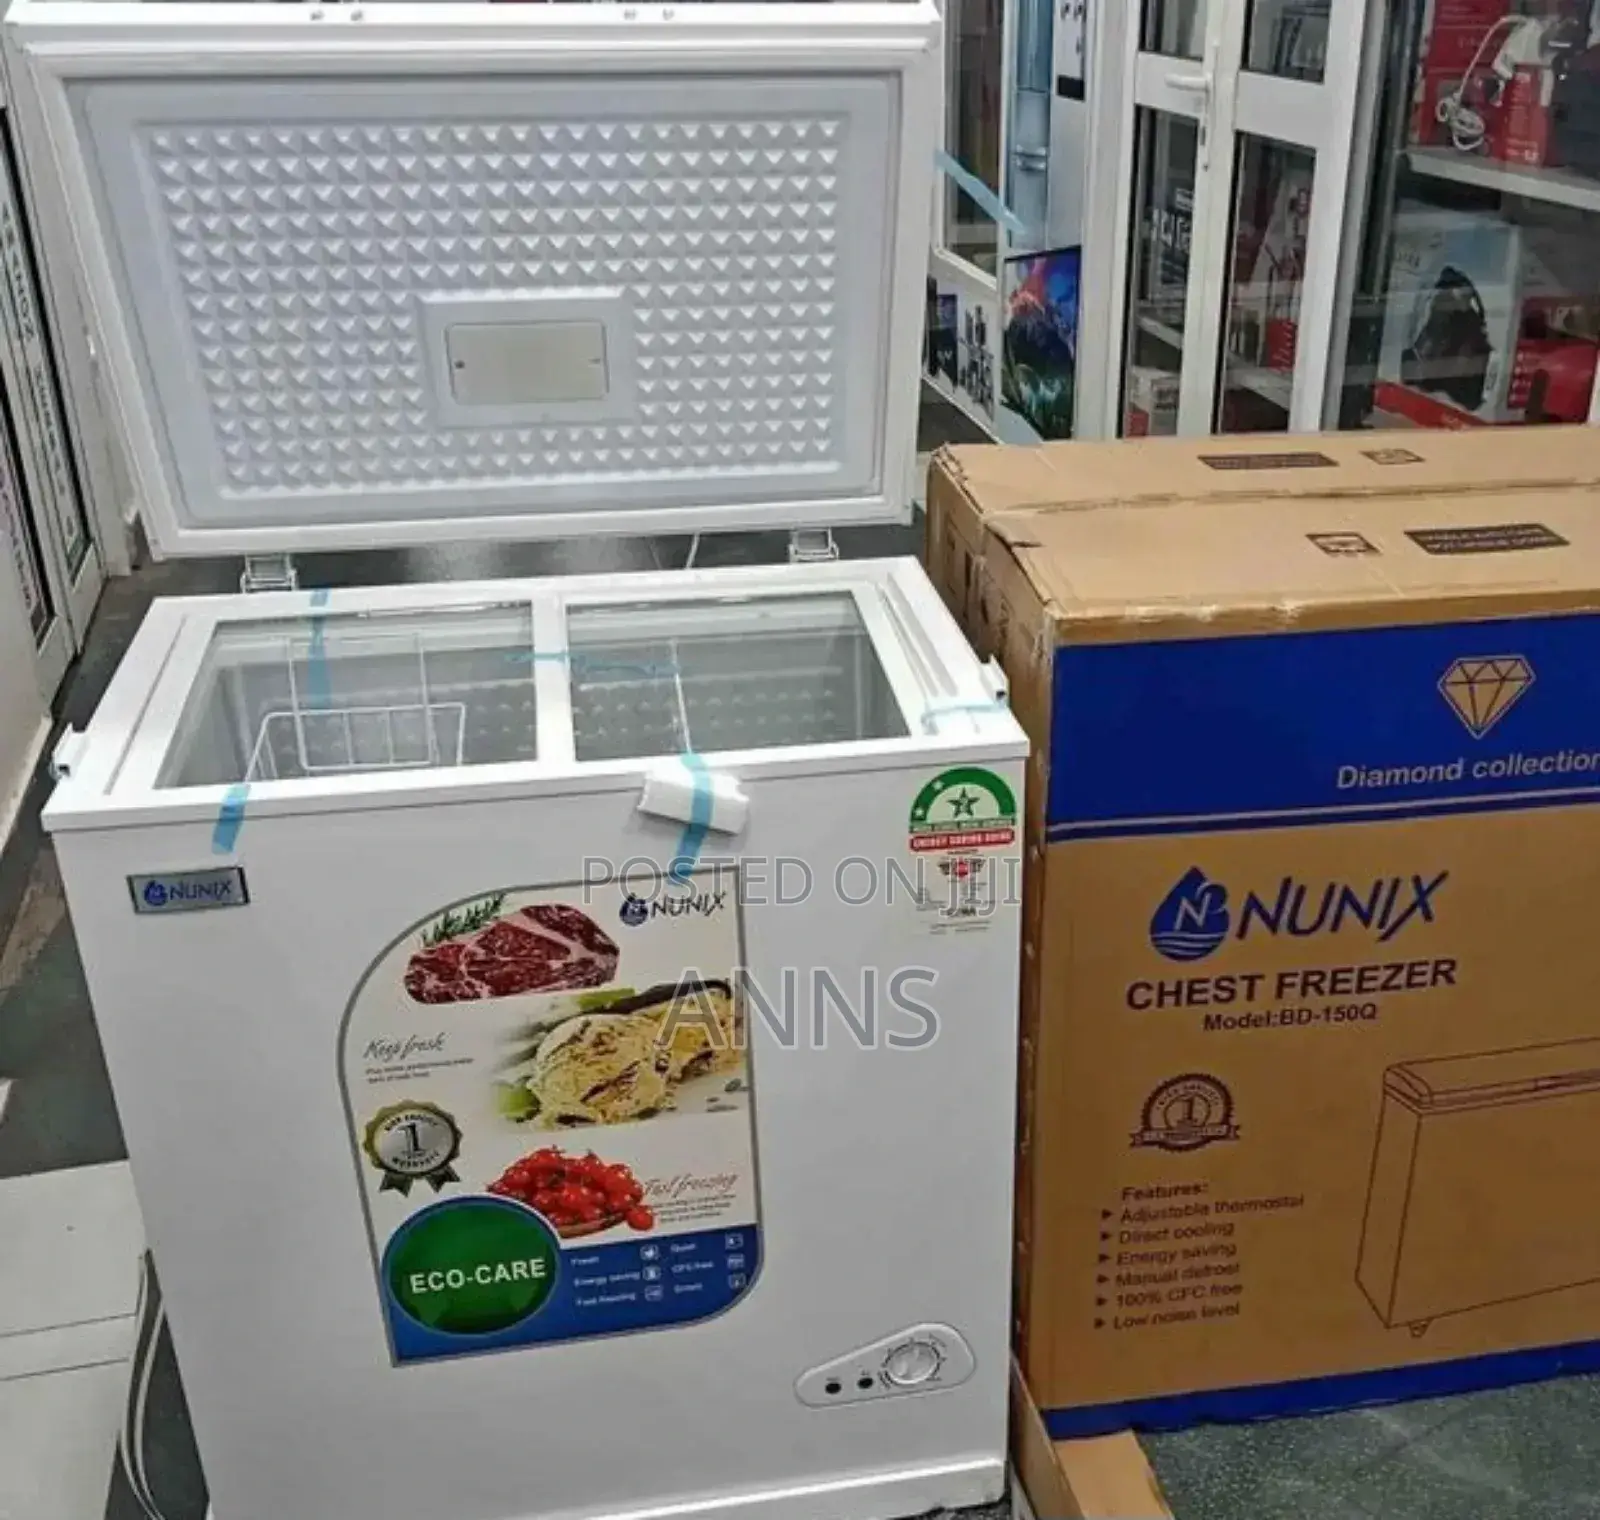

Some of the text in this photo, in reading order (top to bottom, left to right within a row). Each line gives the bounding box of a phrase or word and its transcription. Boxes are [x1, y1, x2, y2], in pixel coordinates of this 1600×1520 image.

[1336, 757, 1464, 789] Diamond
[169, 880, 233, 901] NUNIX
[650, 890, 727, 918] NUNIX
[1236, 869, 1450, 943] NUNIX
[1125, 958, 1458, 1011] CHEST FREEZER
[1203, 1003, 1378, 1033] Model:BD-150Q
[1121, 1182, 1209, 1201] Features:
[1120, 1192, 1305, 1223] Adjustable thermostat
[1119, 1221, 1235, 1245] Direct cooling
[1116, 1242, 1238, 1267] Energy saving
[408, 1257, 548, 1295] ECO-CARE
[1115, 1268, 1178, 1287] Manual
[1117, 1282, 1244, 1310] 100% CFC free
[1113, 1302, 1241, 1330] Low noise level
